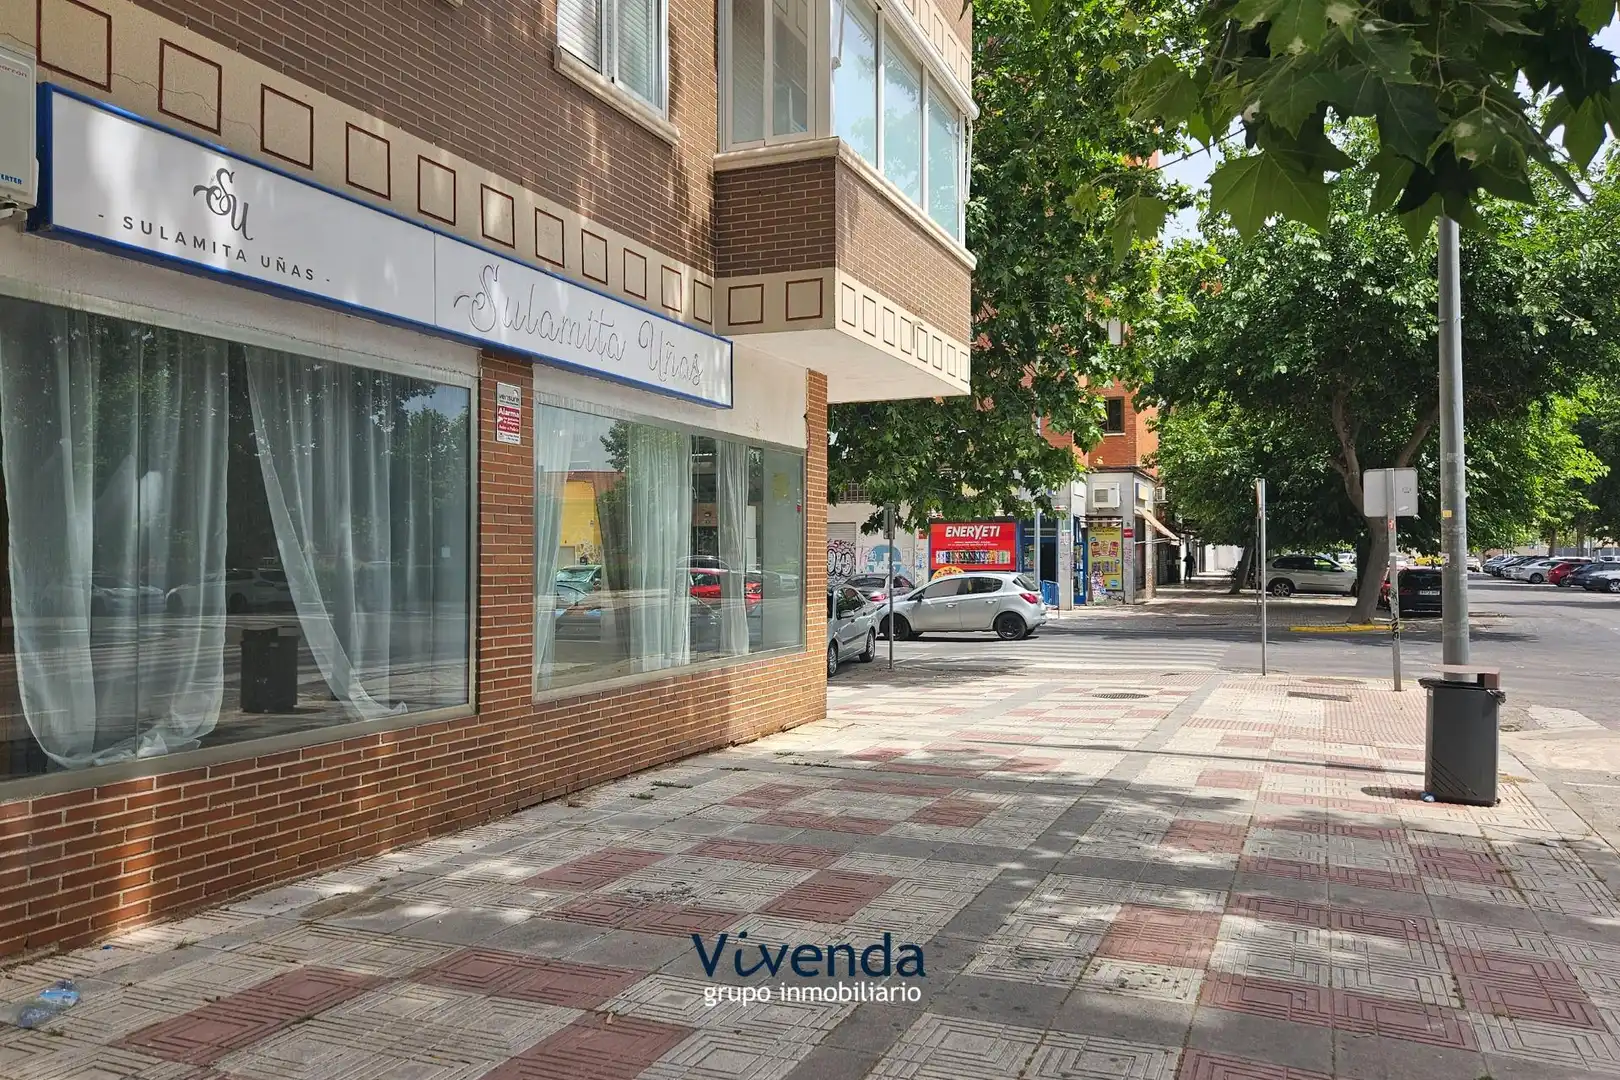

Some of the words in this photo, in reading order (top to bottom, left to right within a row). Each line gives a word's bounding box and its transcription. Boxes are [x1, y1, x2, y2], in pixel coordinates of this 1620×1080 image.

[123, 215, 248, 263] SULAMITA
[260, 255, 317, 282] UÑAS
[454, 263, 627, 362] Sulamita
[638, 319, 704, 387] Uñas
[945, 525, 1001, 540] ENERYETI
